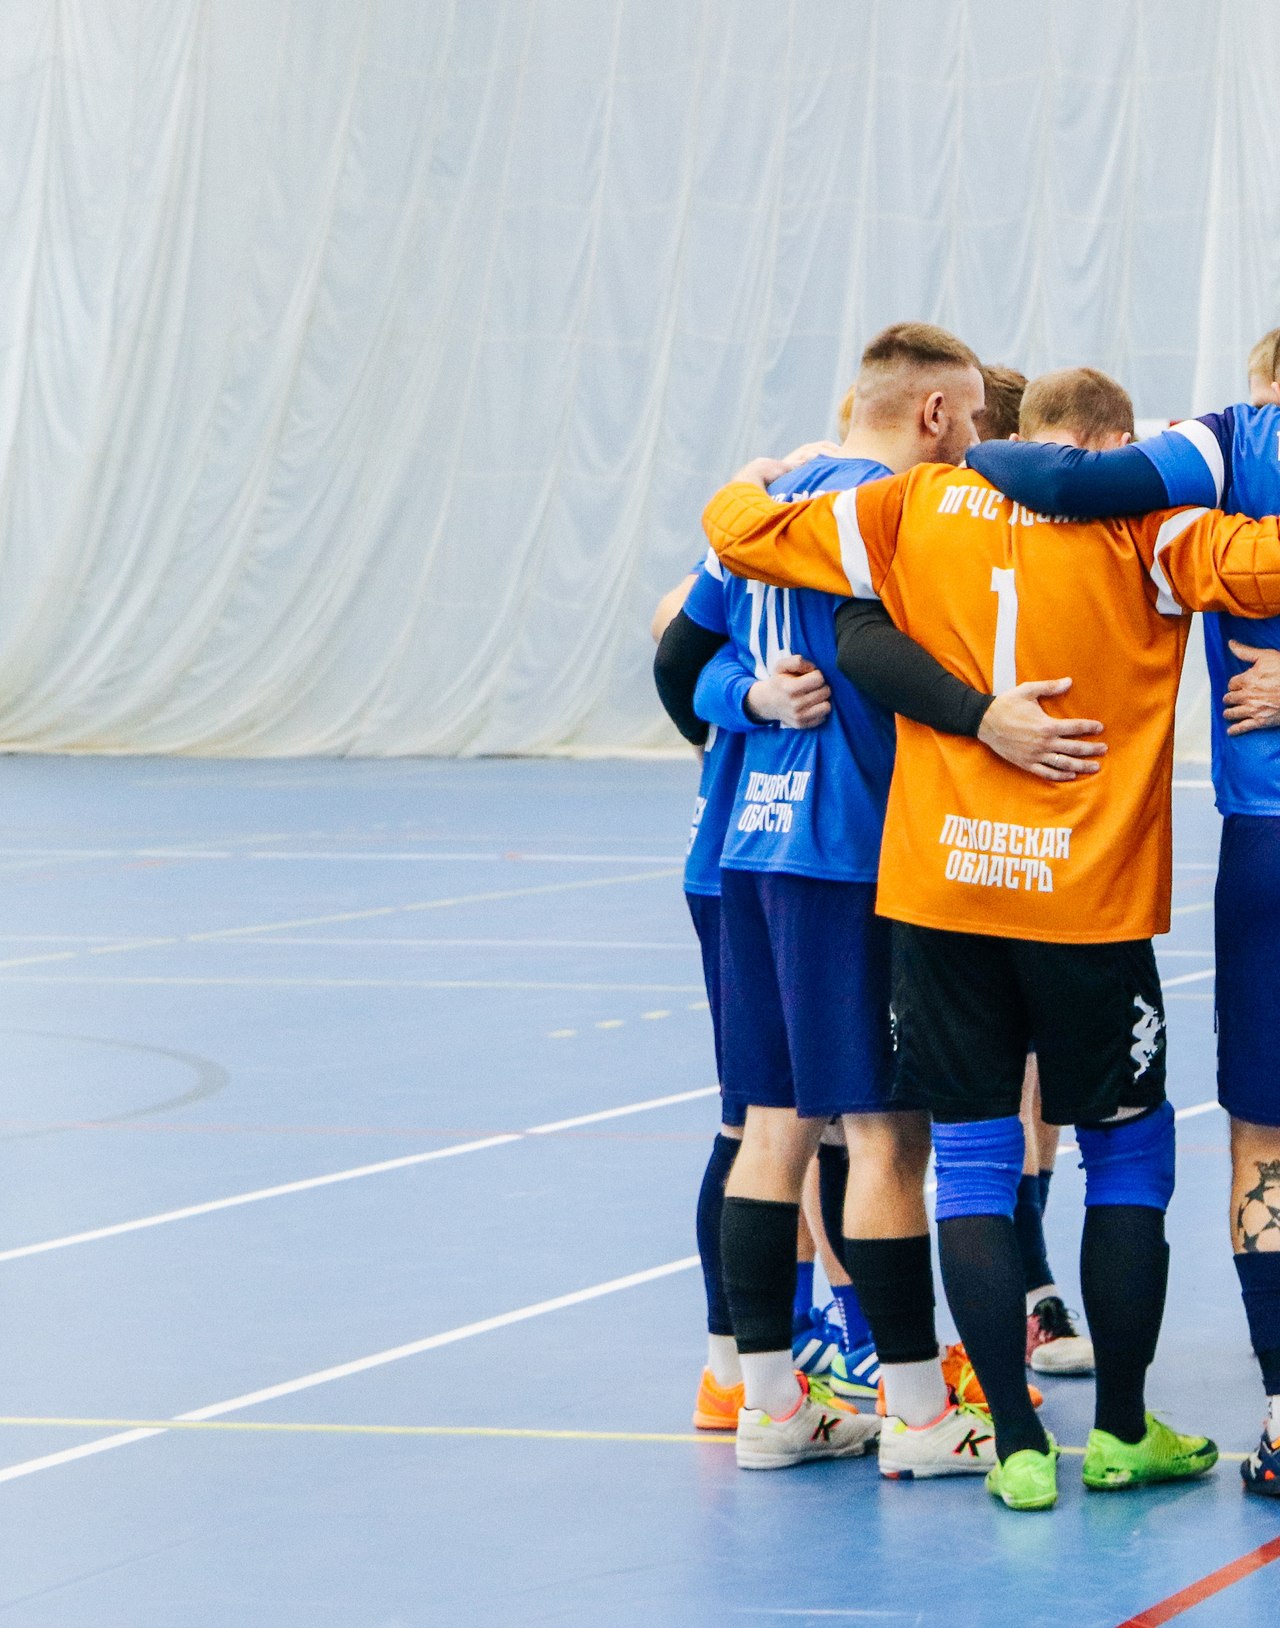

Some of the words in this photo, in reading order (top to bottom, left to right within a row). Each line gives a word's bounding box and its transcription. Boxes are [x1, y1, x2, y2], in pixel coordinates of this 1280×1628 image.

[937, 485, 1006, 521] МЧС
[990, 566, 1019, 697] 1
[938, 814, 1073, 859] ПСКОВСКАЯ
[944, 849, 1054, 893] ОБЛАСТЬ
